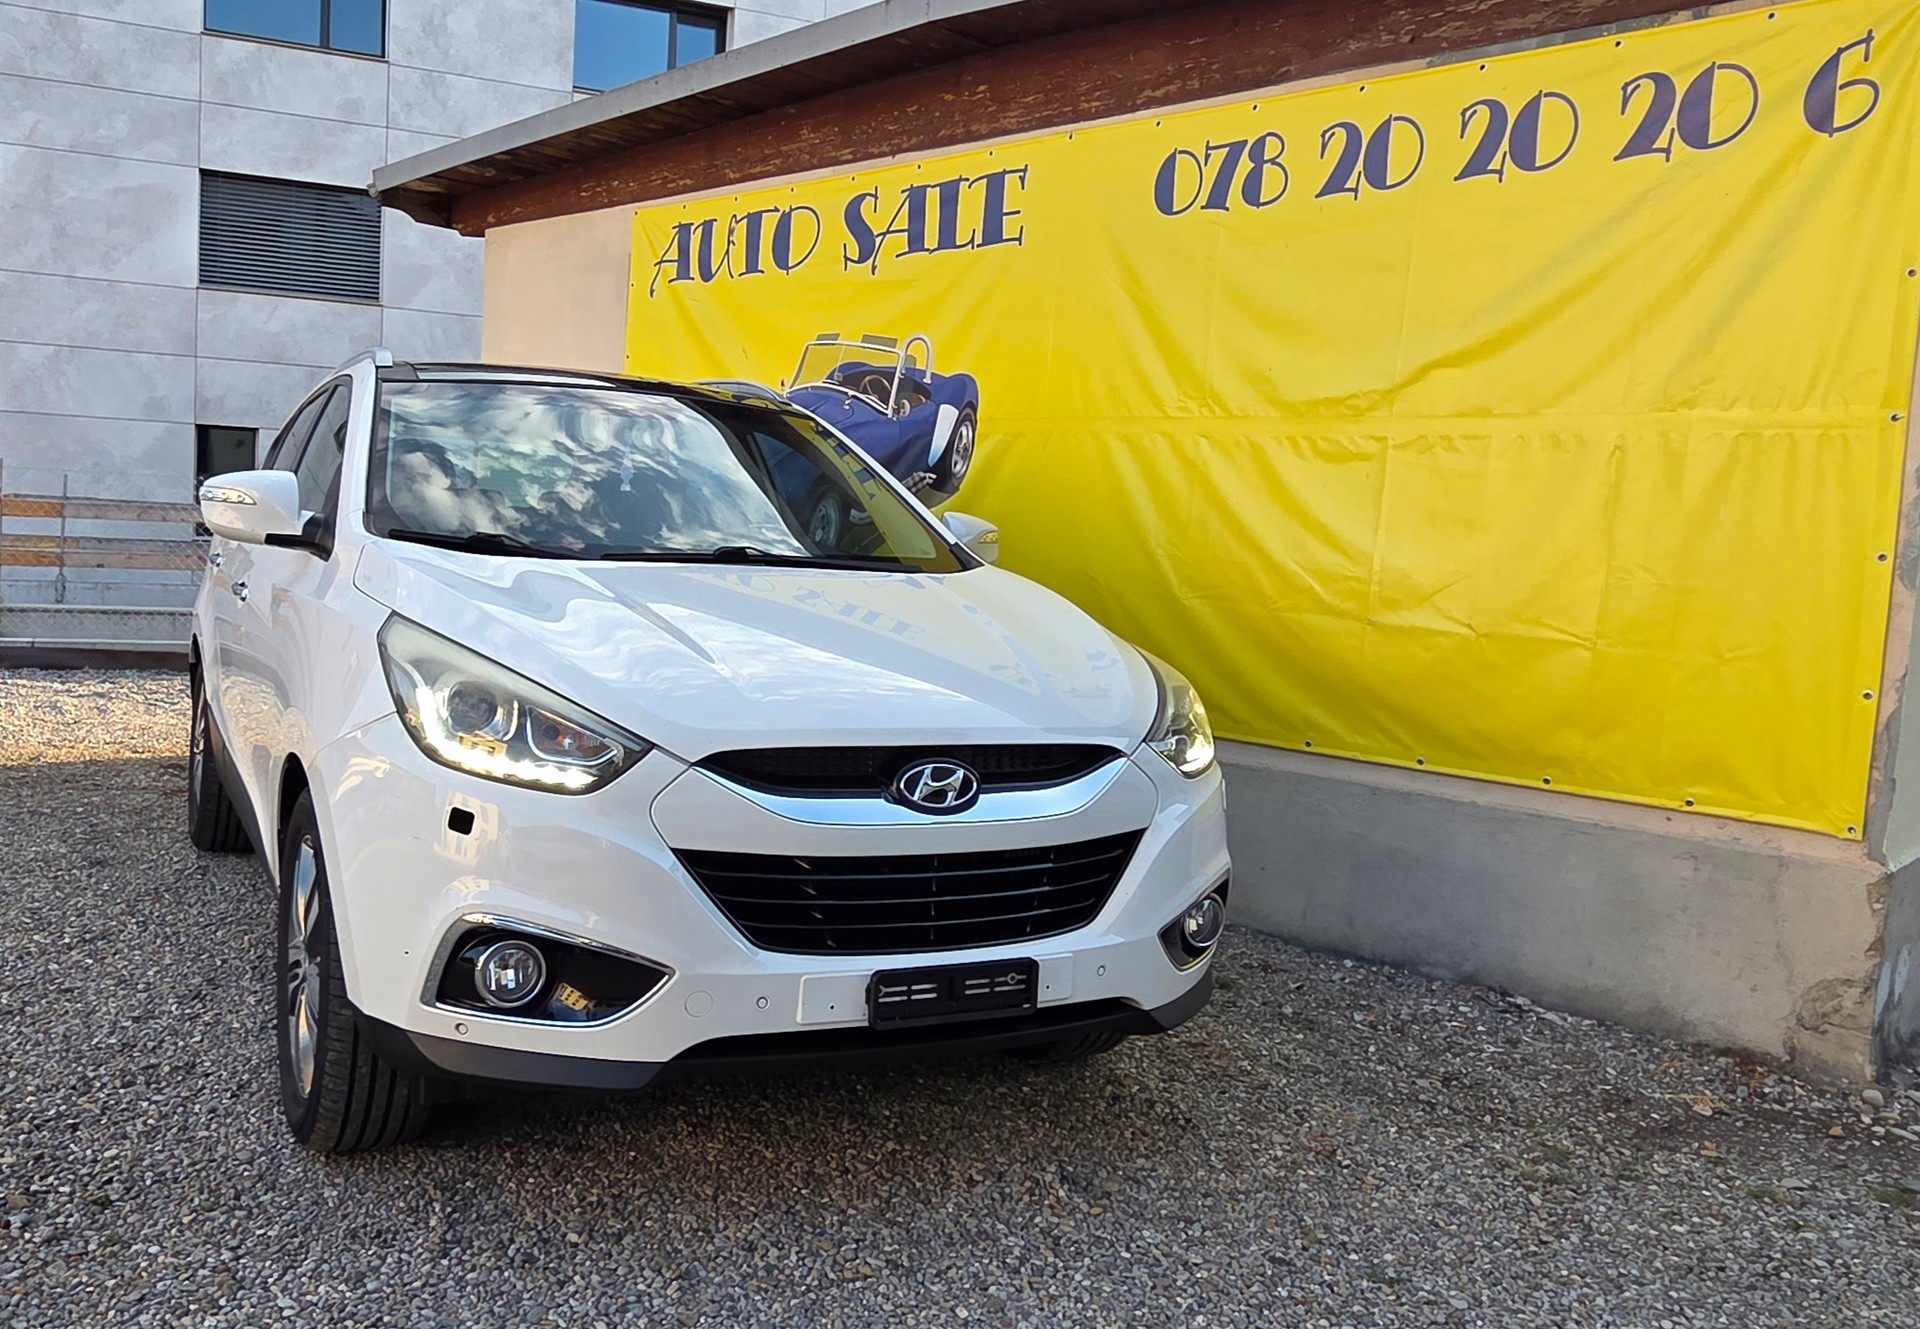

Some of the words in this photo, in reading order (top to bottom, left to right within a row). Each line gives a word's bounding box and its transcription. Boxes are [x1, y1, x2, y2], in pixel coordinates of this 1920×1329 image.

[1153, 132, 1289, 216] 078
[1315, 114, 1424, 201] 20
[1454, 90, 1579, 183] 20
[1614, 61, 1759, 163] 20
[1803, 29, 1880, 136] 6
[650, 205, 821, 297] AUTO
[843, 164, 1028, 275] SALE
